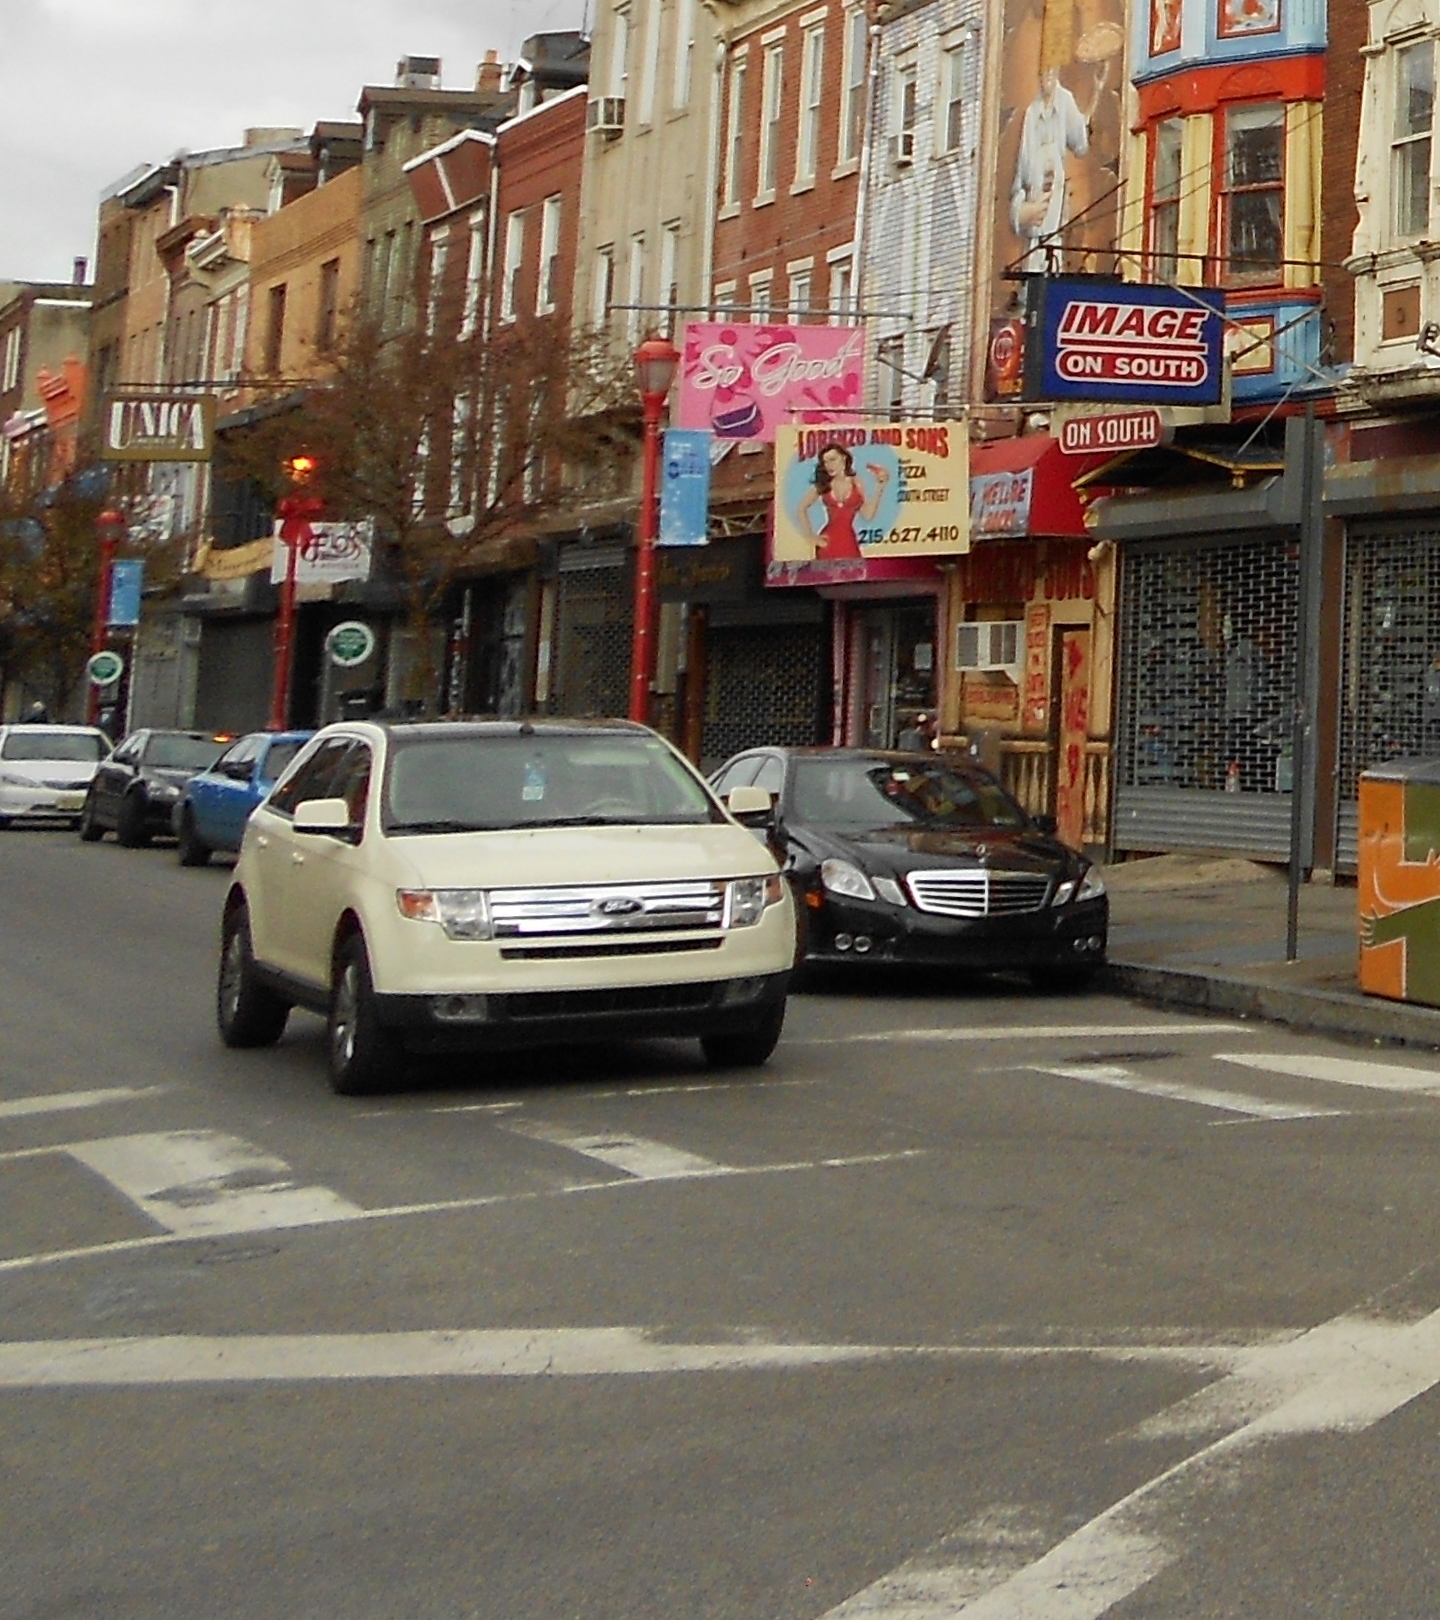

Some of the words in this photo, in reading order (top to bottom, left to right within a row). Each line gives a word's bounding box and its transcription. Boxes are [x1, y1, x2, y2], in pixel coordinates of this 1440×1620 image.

[1060, 303, 1207, 341] IMAGE
[692, 344, 744, 389] So
[1066, 355, 1102, 374] ON
[1114, 356, 1198, 379] SOUTH
[110, 401, 205, 450] UNICA
[1066, 422, 1091, 447] ON
[1097, 416, 1155, 444] SOUTH
[797, 428, 867, 462] LORENZO
[871, 427, 902, 447] AND
[906, 426, 950, 459] SONS
[898, 465, 927, 479] PIZZA
[858, 525, 960, 545] 215.627.4110
